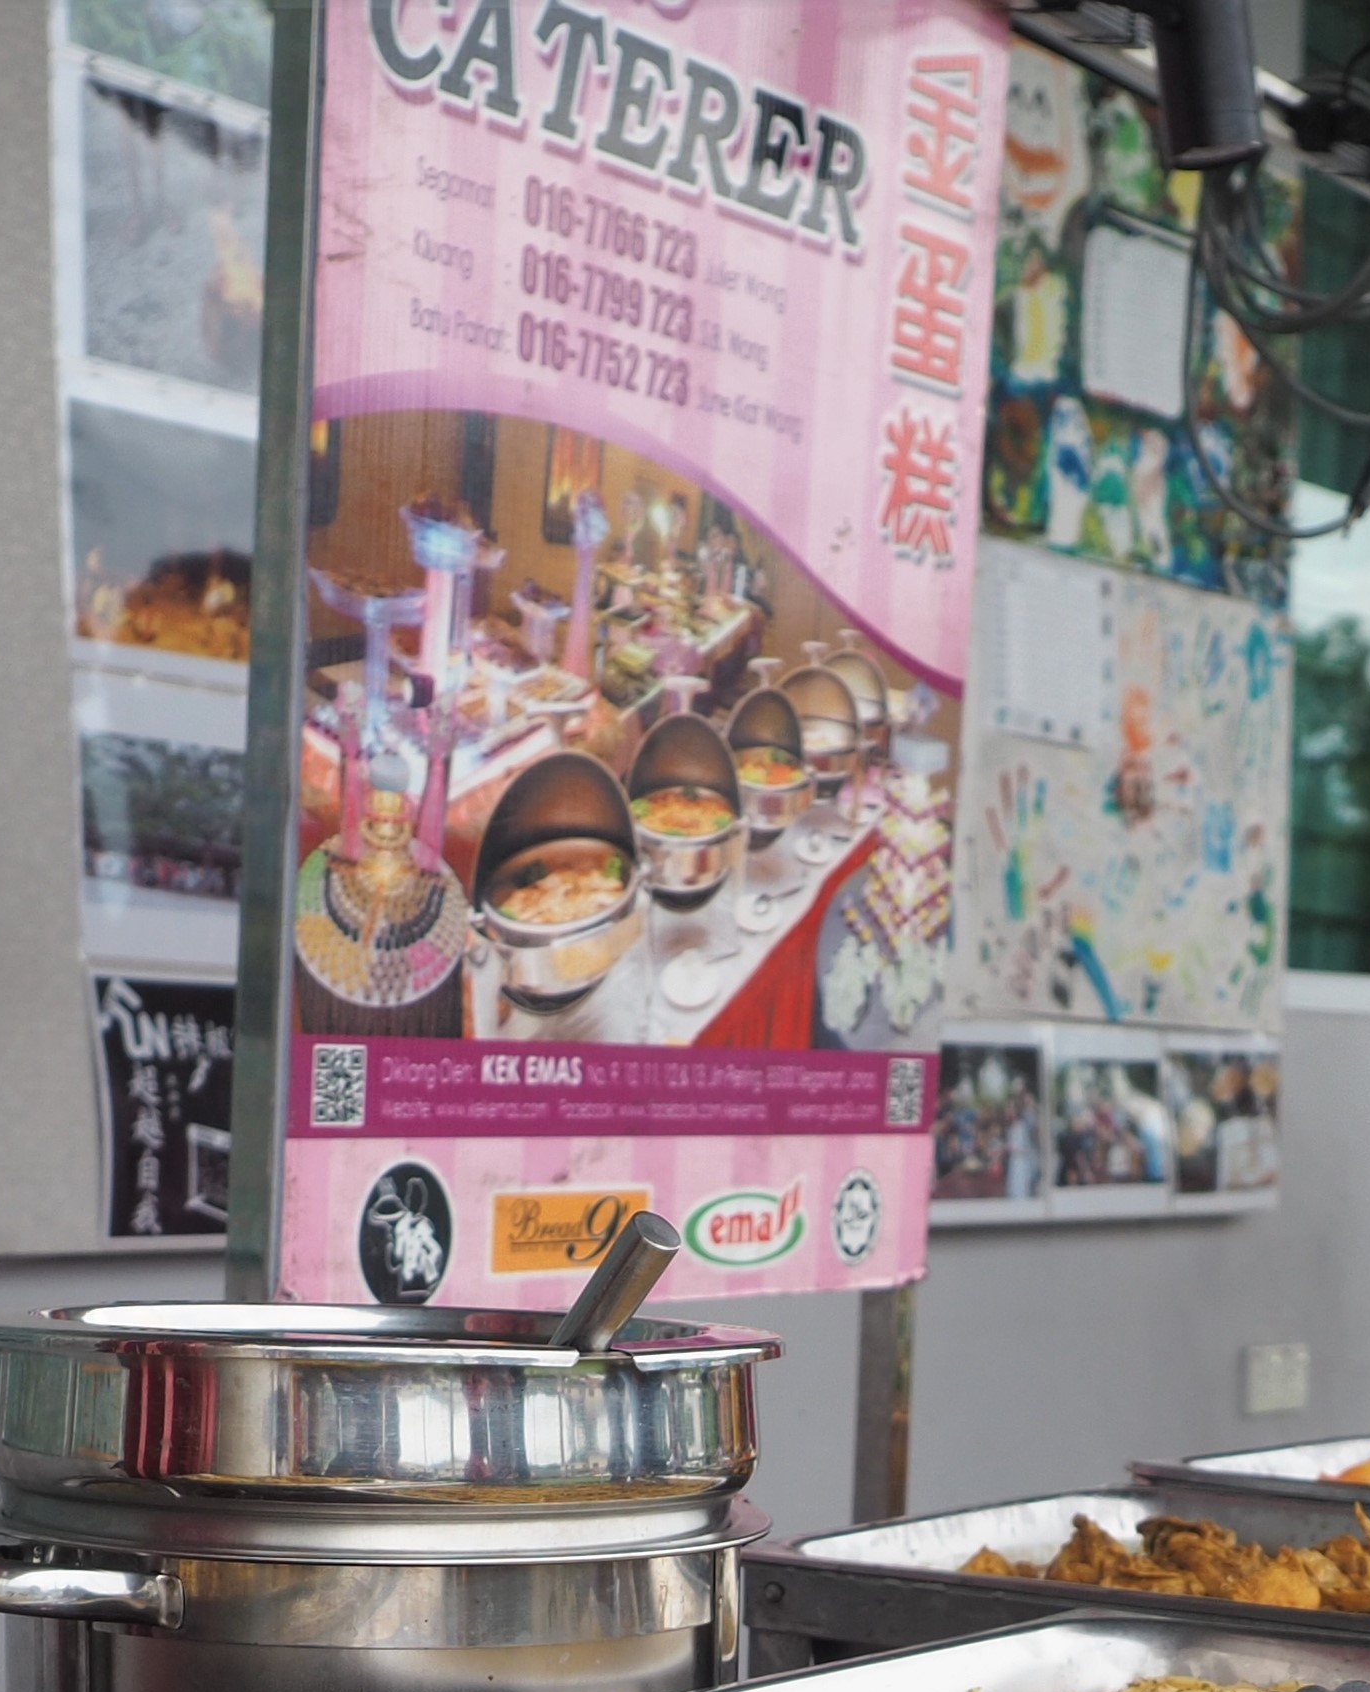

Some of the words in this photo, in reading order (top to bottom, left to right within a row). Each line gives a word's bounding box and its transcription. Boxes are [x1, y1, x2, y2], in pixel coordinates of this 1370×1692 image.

[369, 0, 867, 250] CATERER
[417, 155, 497, 208] Segamat
[524, 174, 648, 263] 016-7766
[651, 218, 697, 280] 723
[520, 243, 643, 328] 016-7799
[649, 284, 694, 344] 723
[517, 310, 641, 392] 016-7752
[645, 349, 690, 407] 723
[481, 1054, 522, 1085] KEK
[524, 1055, 583, 1086] EMAS
